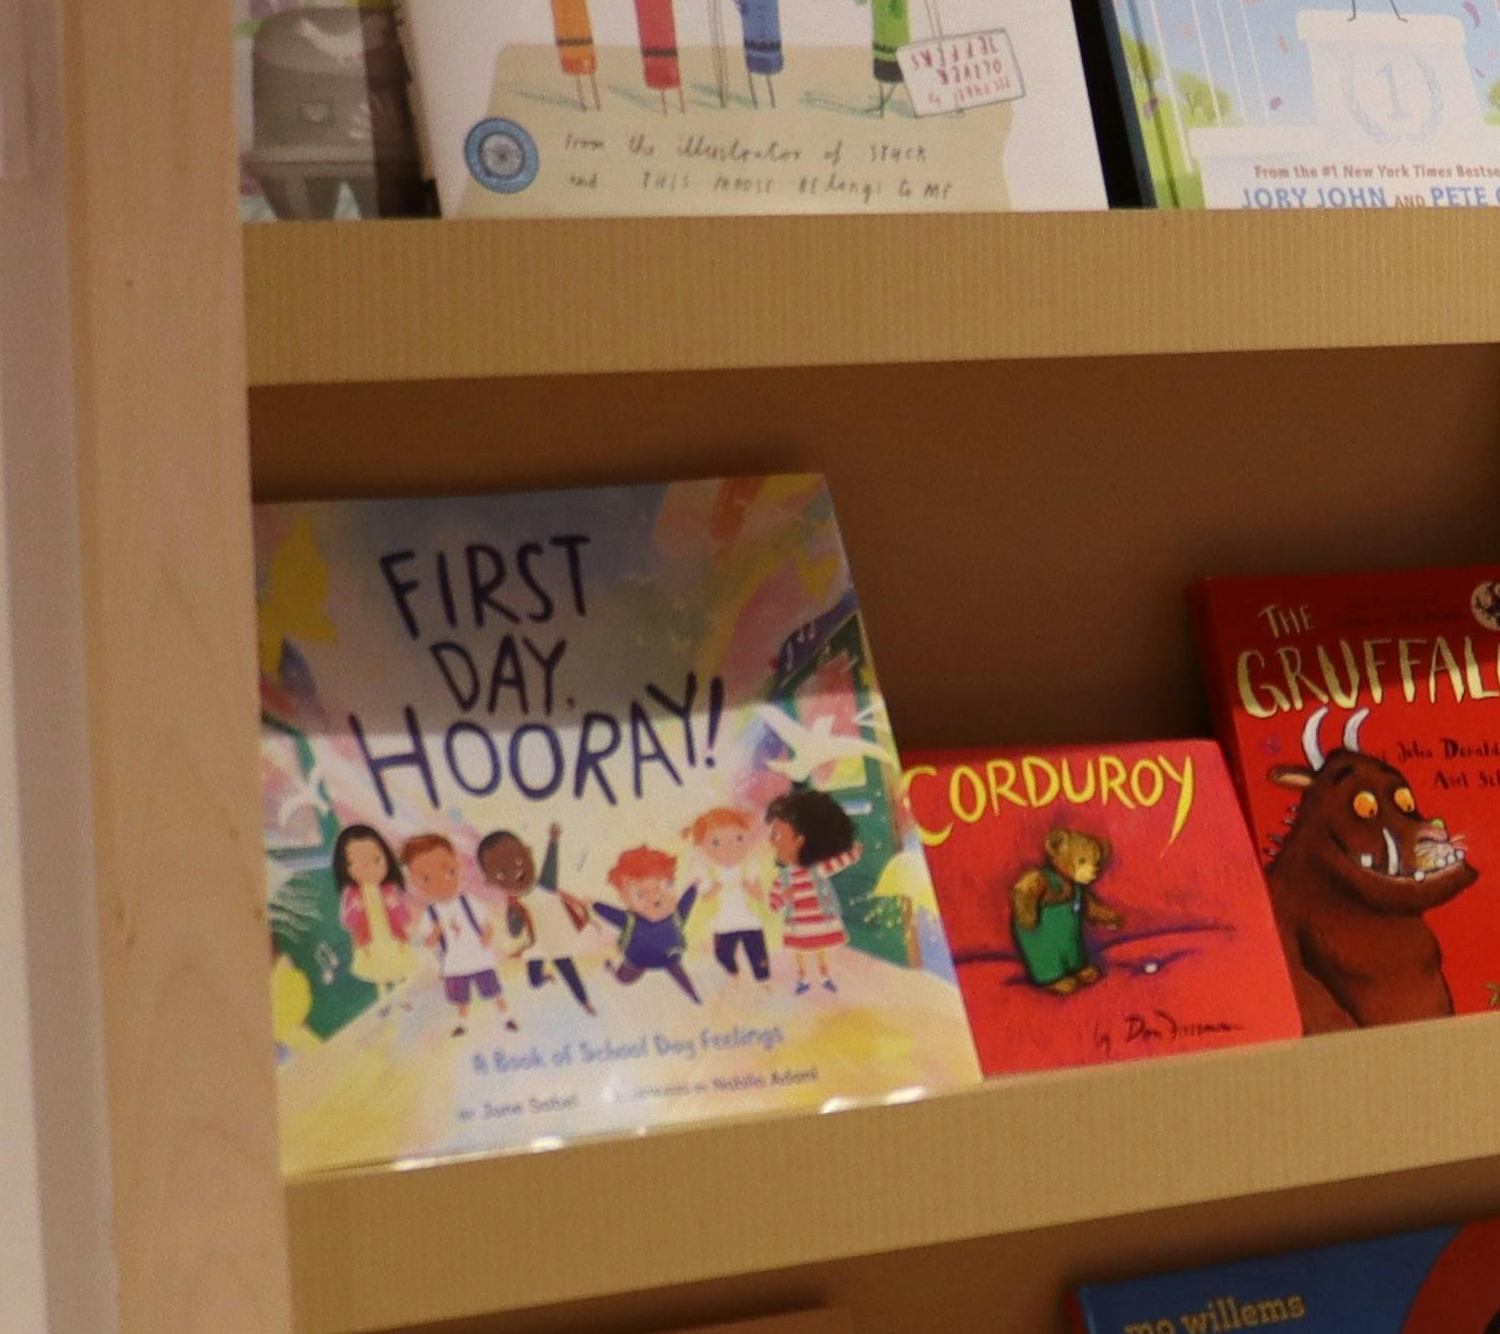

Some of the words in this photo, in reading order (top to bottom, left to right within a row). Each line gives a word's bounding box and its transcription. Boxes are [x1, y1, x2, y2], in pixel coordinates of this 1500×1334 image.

[1241, 186, 1310, 209] JORY
[1315, 186, 1387, 209] JOHN
[1393, 195, 1426, 209] AND
[1430, 186, 1490, 209] PETE
[1254, 163, 1291, 180] From
[1293, 163, 1319, 180] the
[1342, 164, 1374, 180] New
[1376, 164, 1409, 180] York
[1412, 164, 1453, 180] Times
[378, 533, 593, 641] FIRST
[1257, 602, 1316, 642] THE
[347, 671, 727, 818] HOORAY!
[901, 753, 1196, 859] CORDUROY
